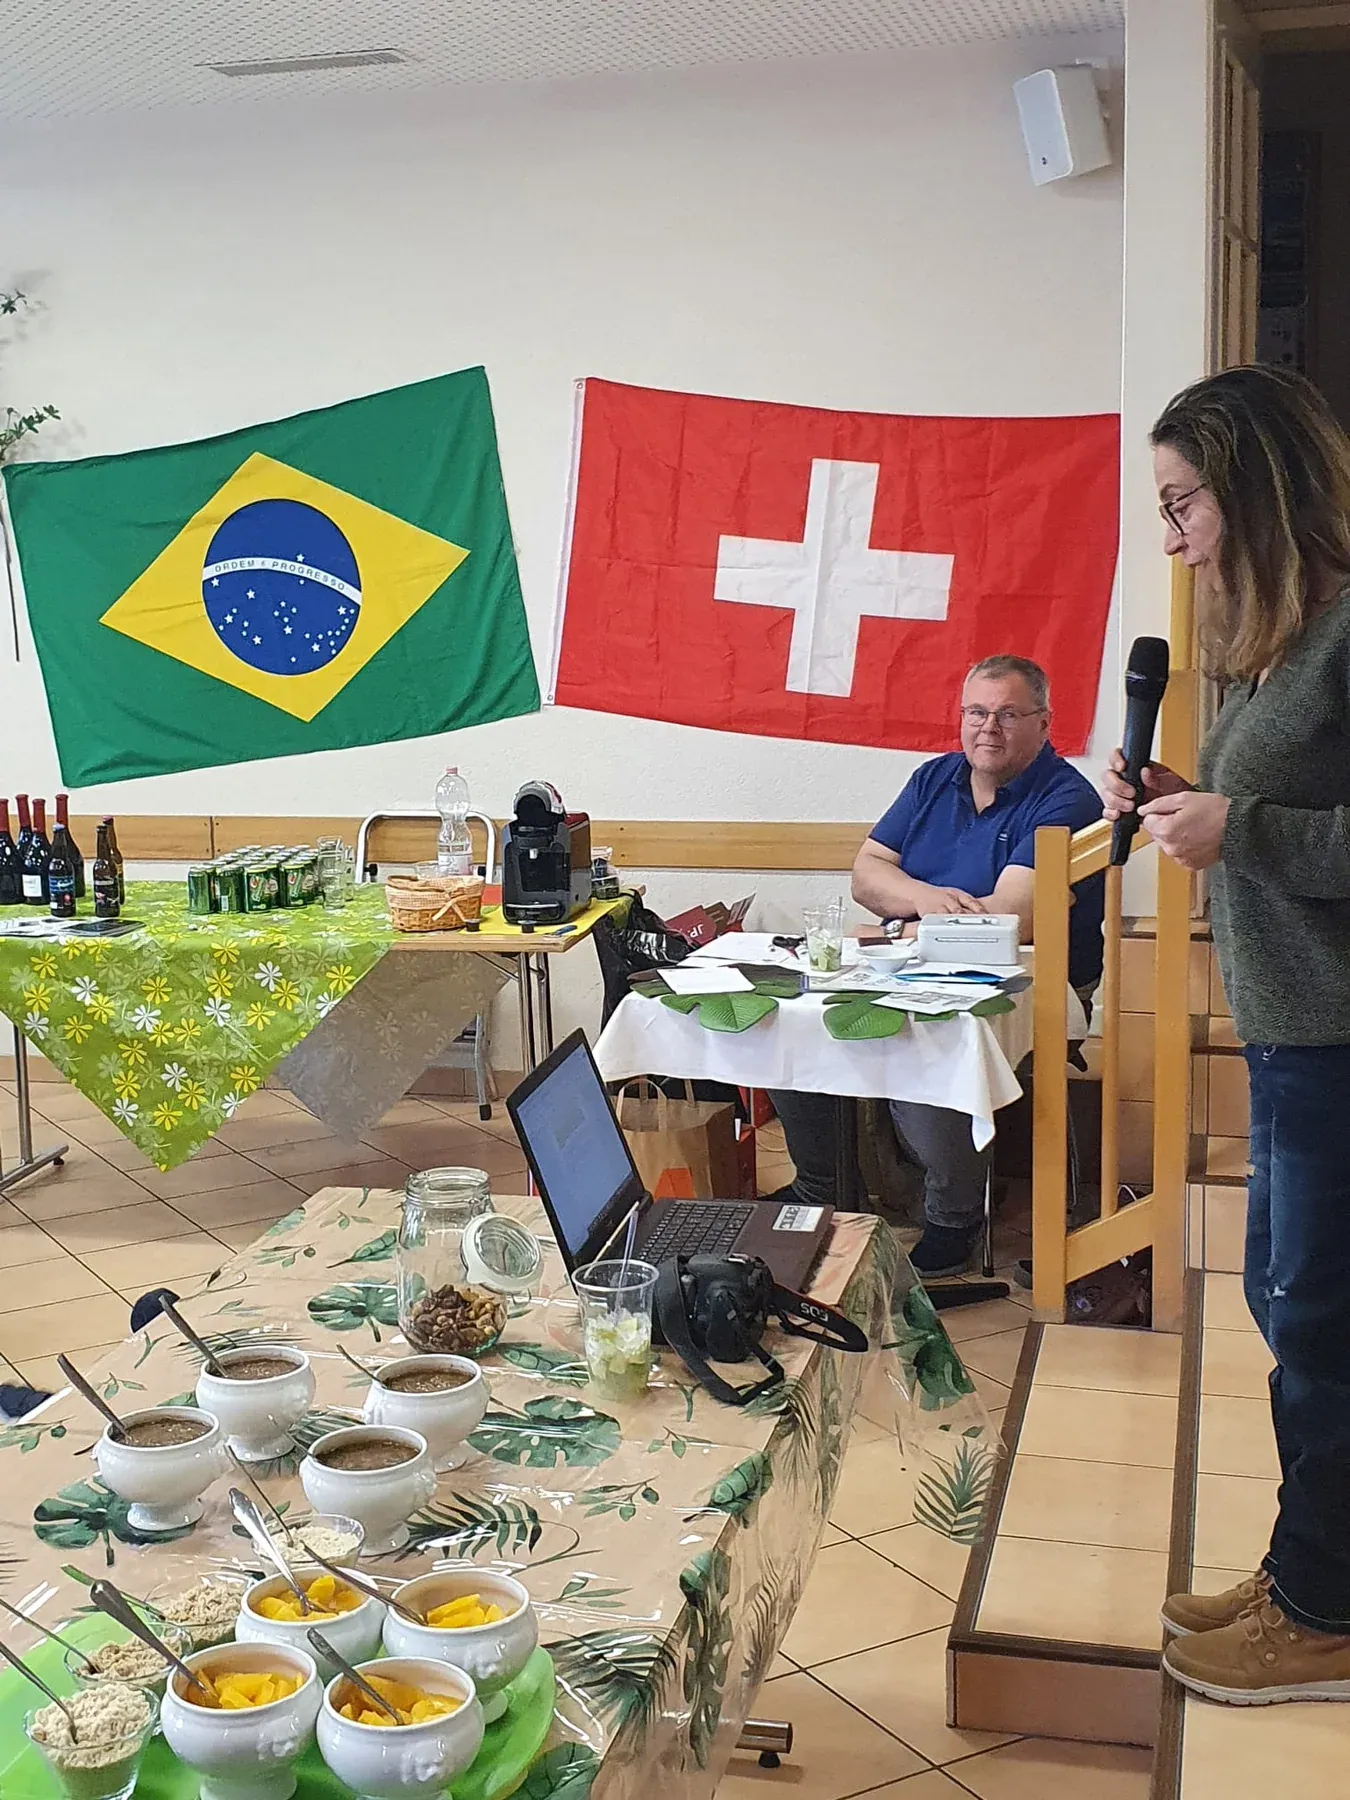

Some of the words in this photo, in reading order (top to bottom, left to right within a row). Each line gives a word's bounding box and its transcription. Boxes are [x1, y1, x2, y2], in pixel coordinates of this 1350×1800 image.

[215, 560, 255, 572] ORDEM
[271, 561, 345, 591] PROGRESSO
[800, 1302, 829, 1322] EOS
